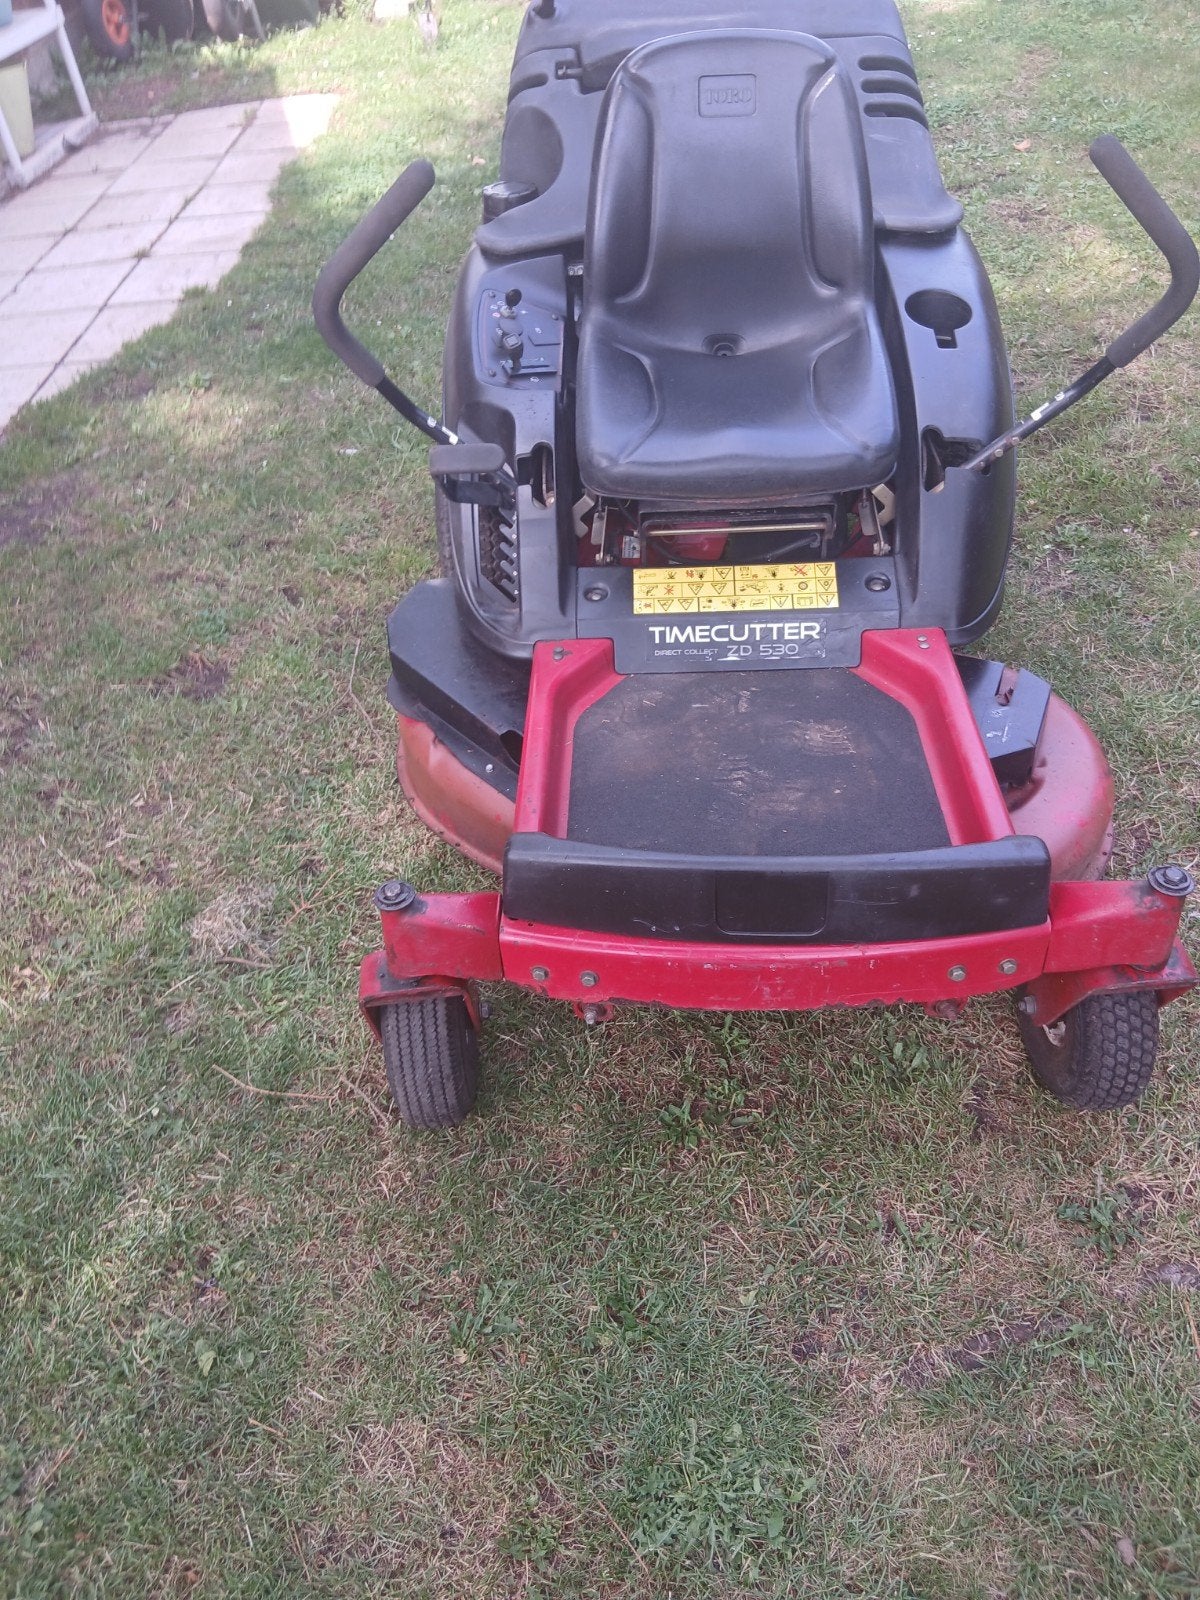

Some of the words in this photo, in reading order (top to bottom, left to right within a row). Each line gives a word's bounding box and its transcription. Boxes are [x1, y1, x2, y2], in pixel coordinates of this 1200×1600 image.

[705, 87, 752, 105] TORO
[649, 622, 820, 643] TIMECUTTER
[684, 648, 718, 656] COLLECT
[727, 645, 752, 656] ZD
[760, 643, 799, 655] 530
